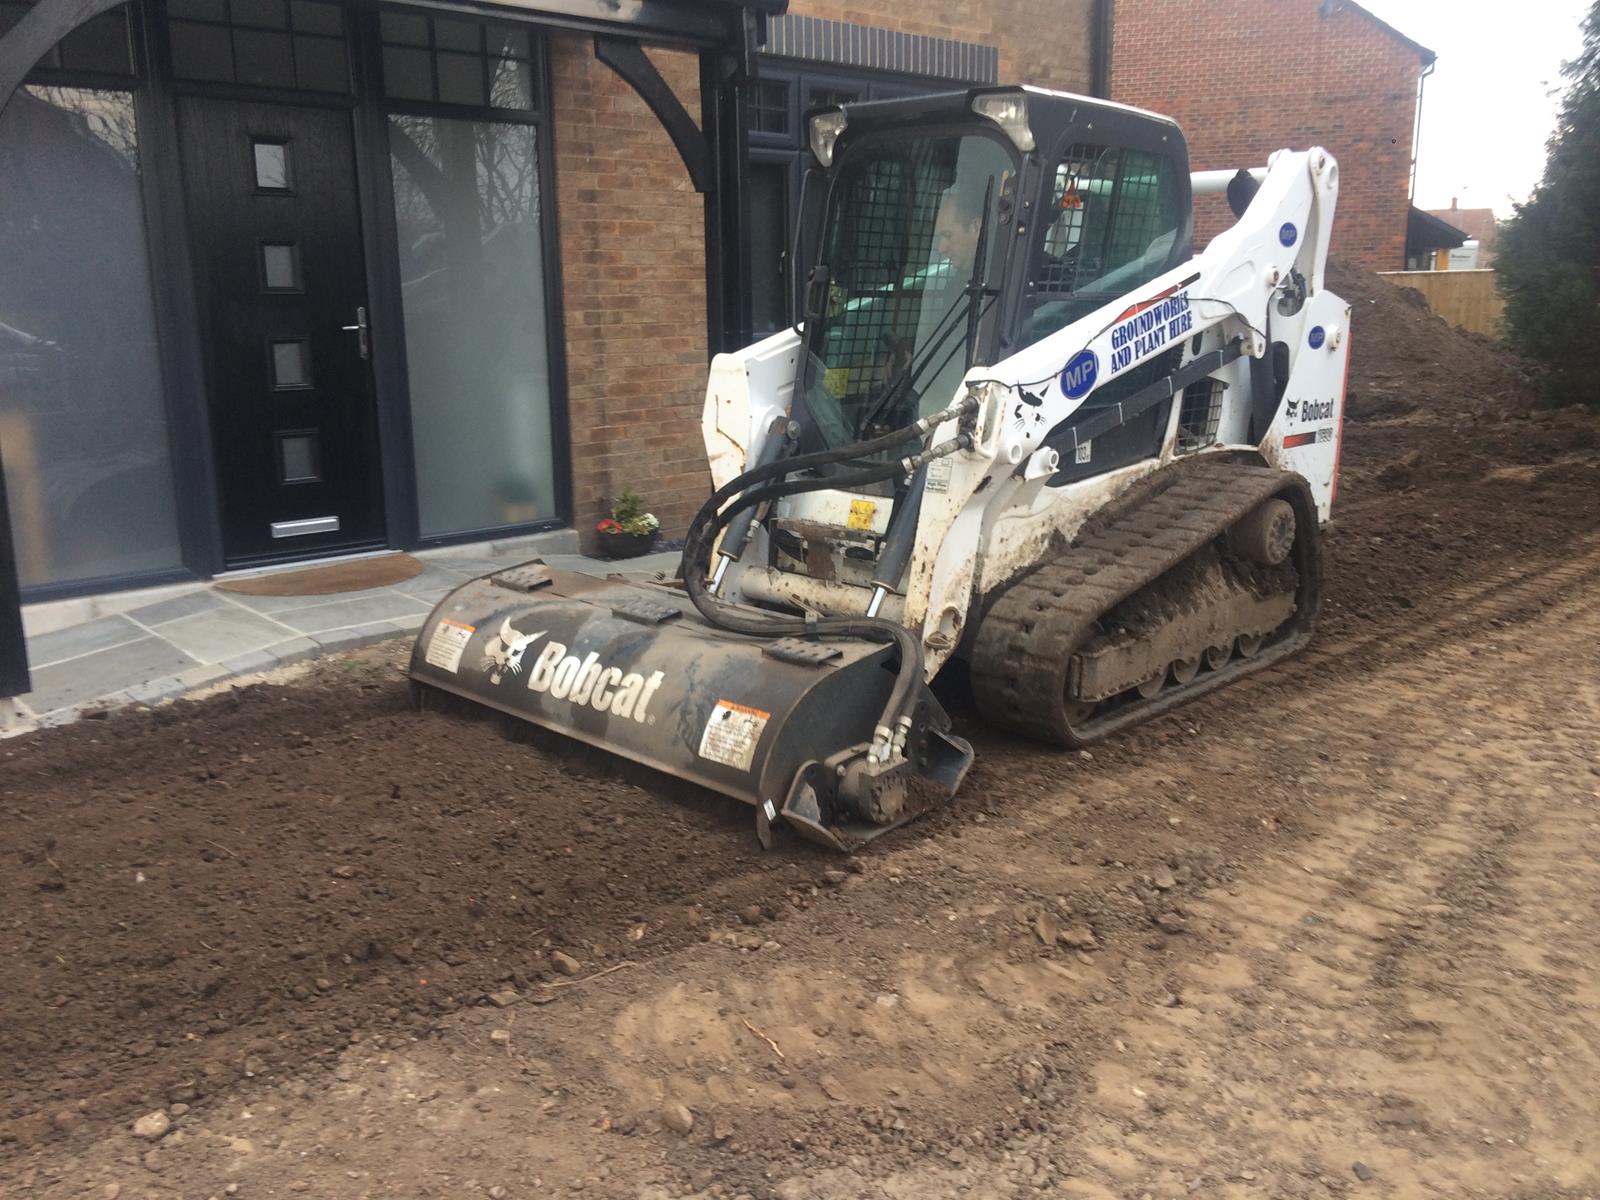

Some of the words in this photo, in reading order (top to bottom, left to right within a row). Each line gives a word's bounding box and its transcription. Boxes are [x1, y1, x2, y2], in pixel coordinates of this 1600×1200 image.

[1111, 290, 1190, 351] GROUNDWORKS
[1111, 345, 1132, 375] AND
[1134, 324, 1166, 361] PLANT
[1169, 310, 1193, 341] HIRE
[1066, 359, 1094, 392] MP
[1301, 398, 1334, 422] Bobcat
[528, 640, 665, 723] Bobcat
